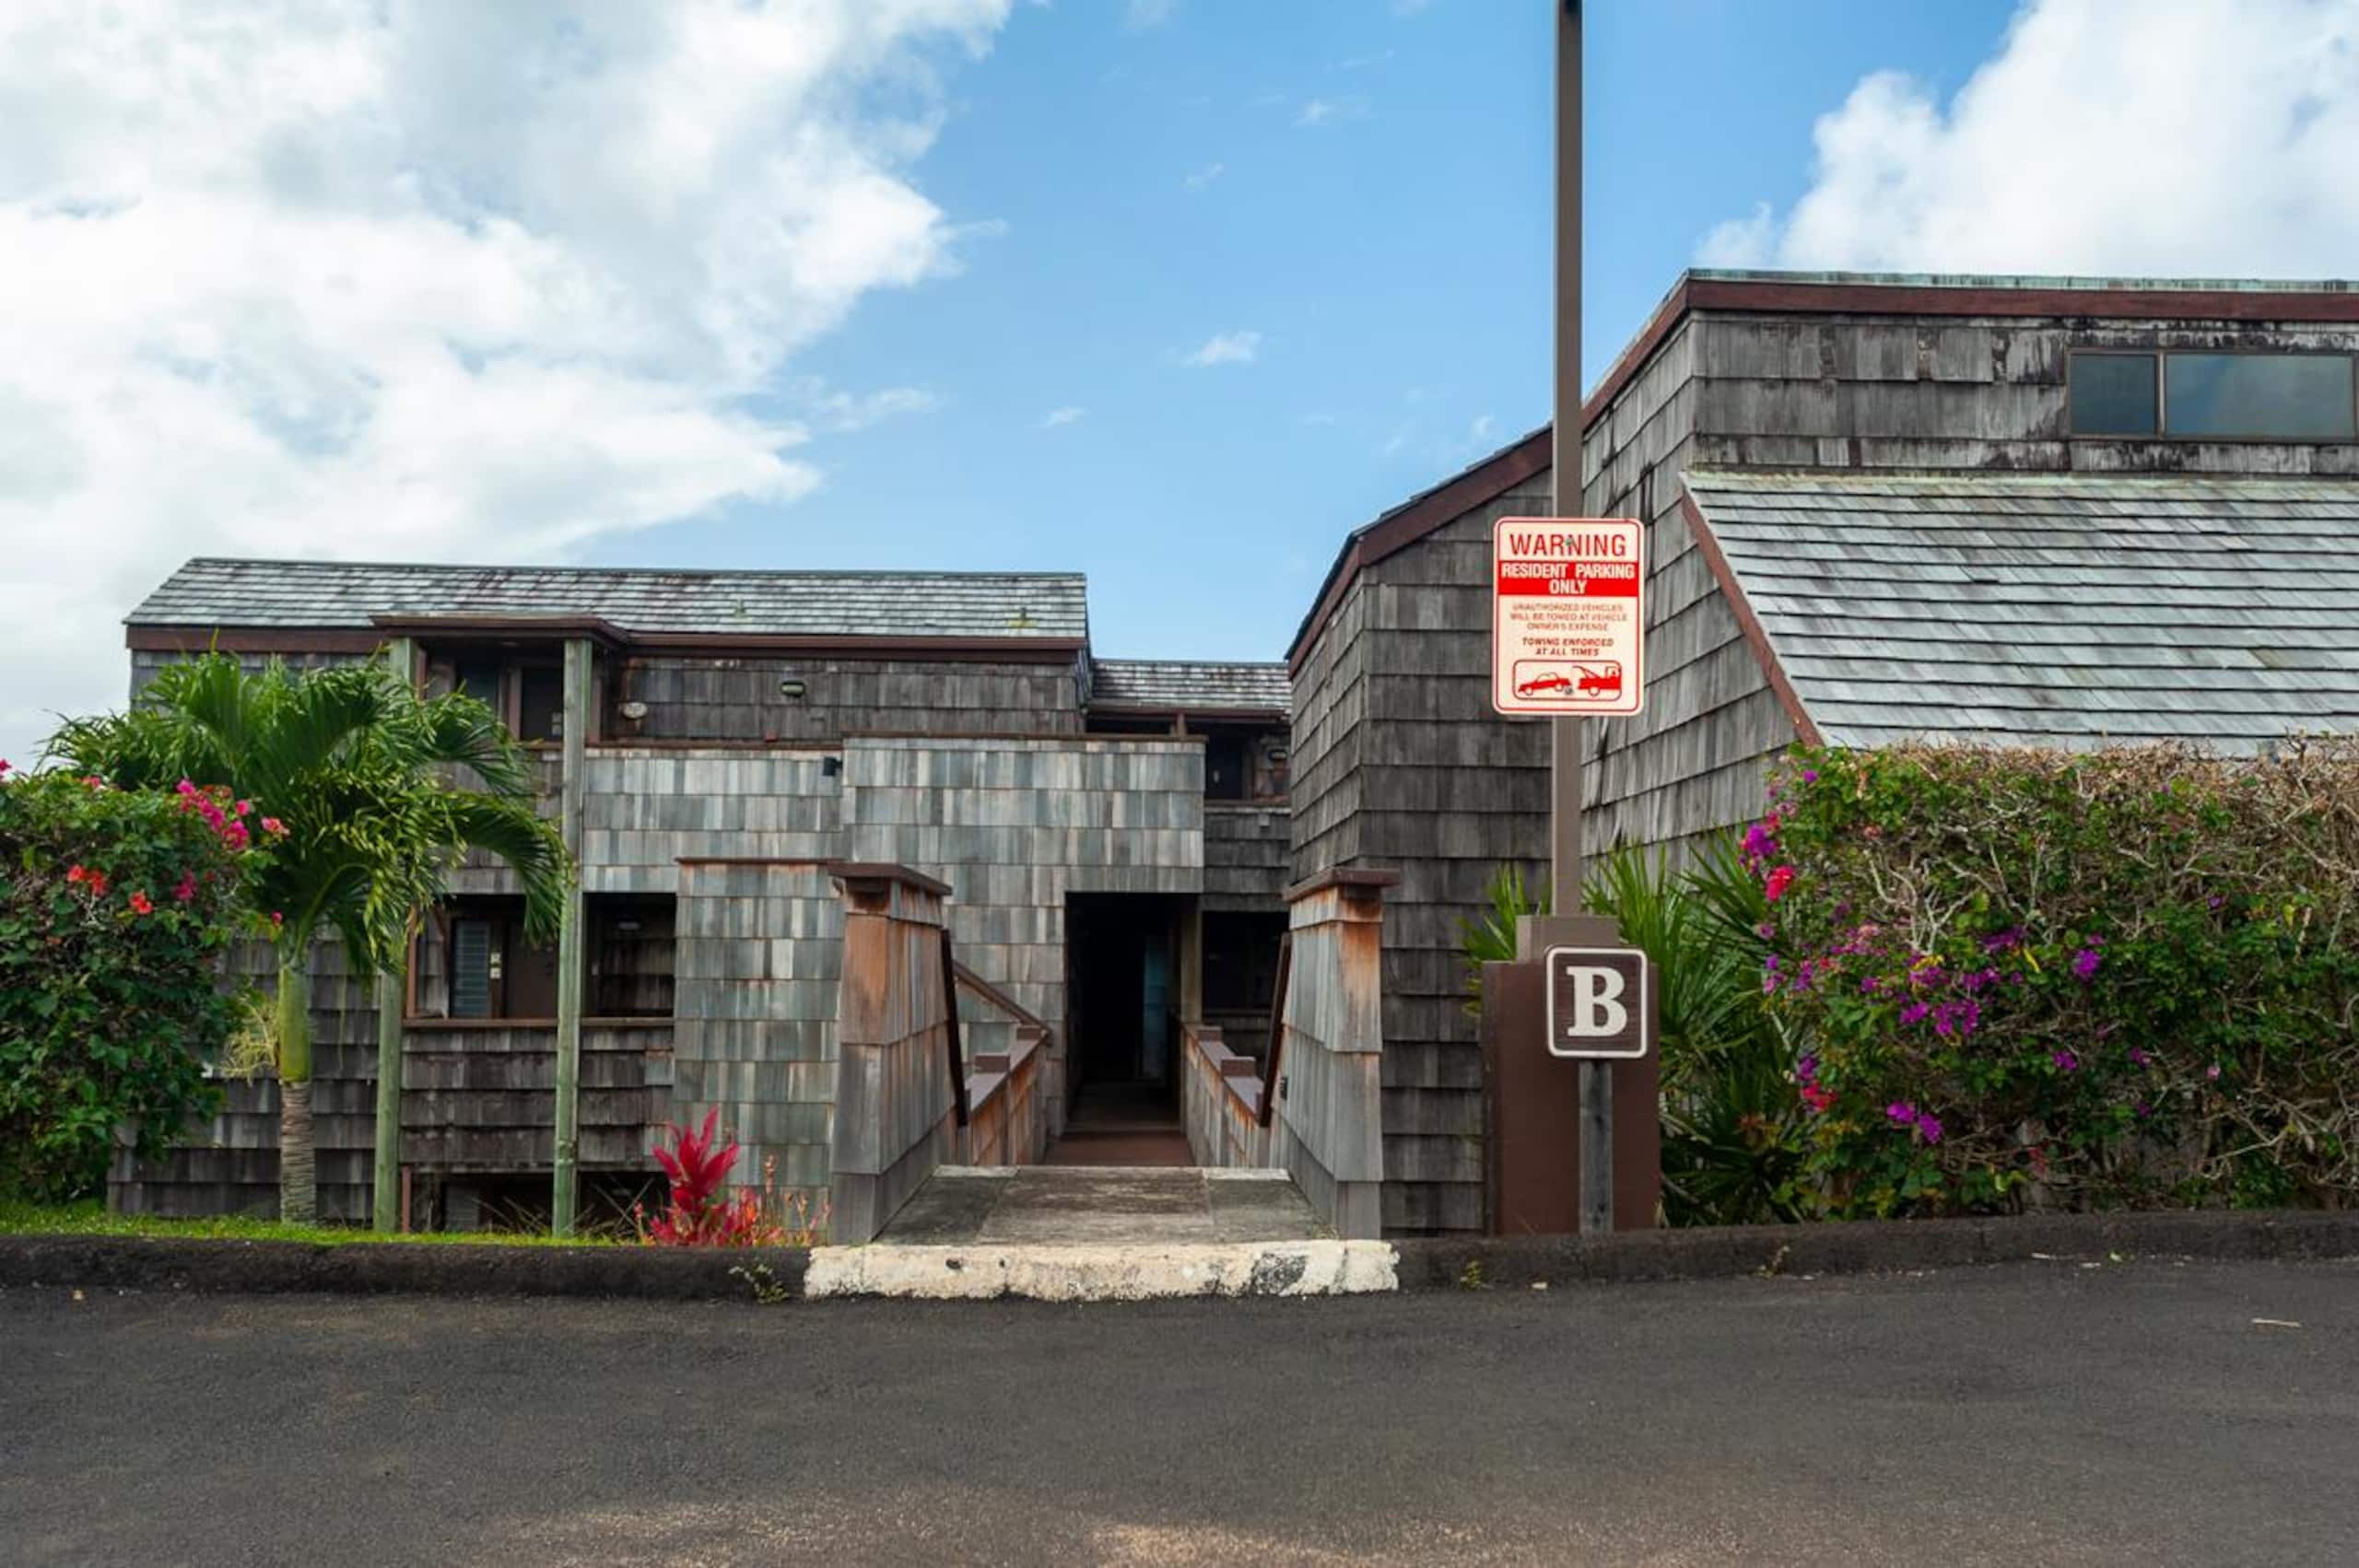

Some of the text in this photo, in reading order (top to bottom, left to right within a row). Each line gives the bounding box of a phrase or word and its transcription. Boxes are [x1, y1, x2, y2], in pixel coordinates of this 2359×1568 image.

[1509, 533, 1626, 556] WARNING
[1501, 563, 1636, 579] RESIDENT PARKING
[1549, 579, 1588, 594] ONLY
[1512, 603, 1624, 613] UNAUTHORIZED VEHICLES
[1579, 613, 1590, 621] AT
[1591, 613, 1627, 621] VEHICLE
[1568, 623, 1608, 631] EXPENSE
[1522, 638, 1614, 647] TOWING ENFORCED
[1550, 648, 1567, 656] ALL
[1571, 648, 1600, 656] TIMES
[1567, 966, 1627, 1036] B
